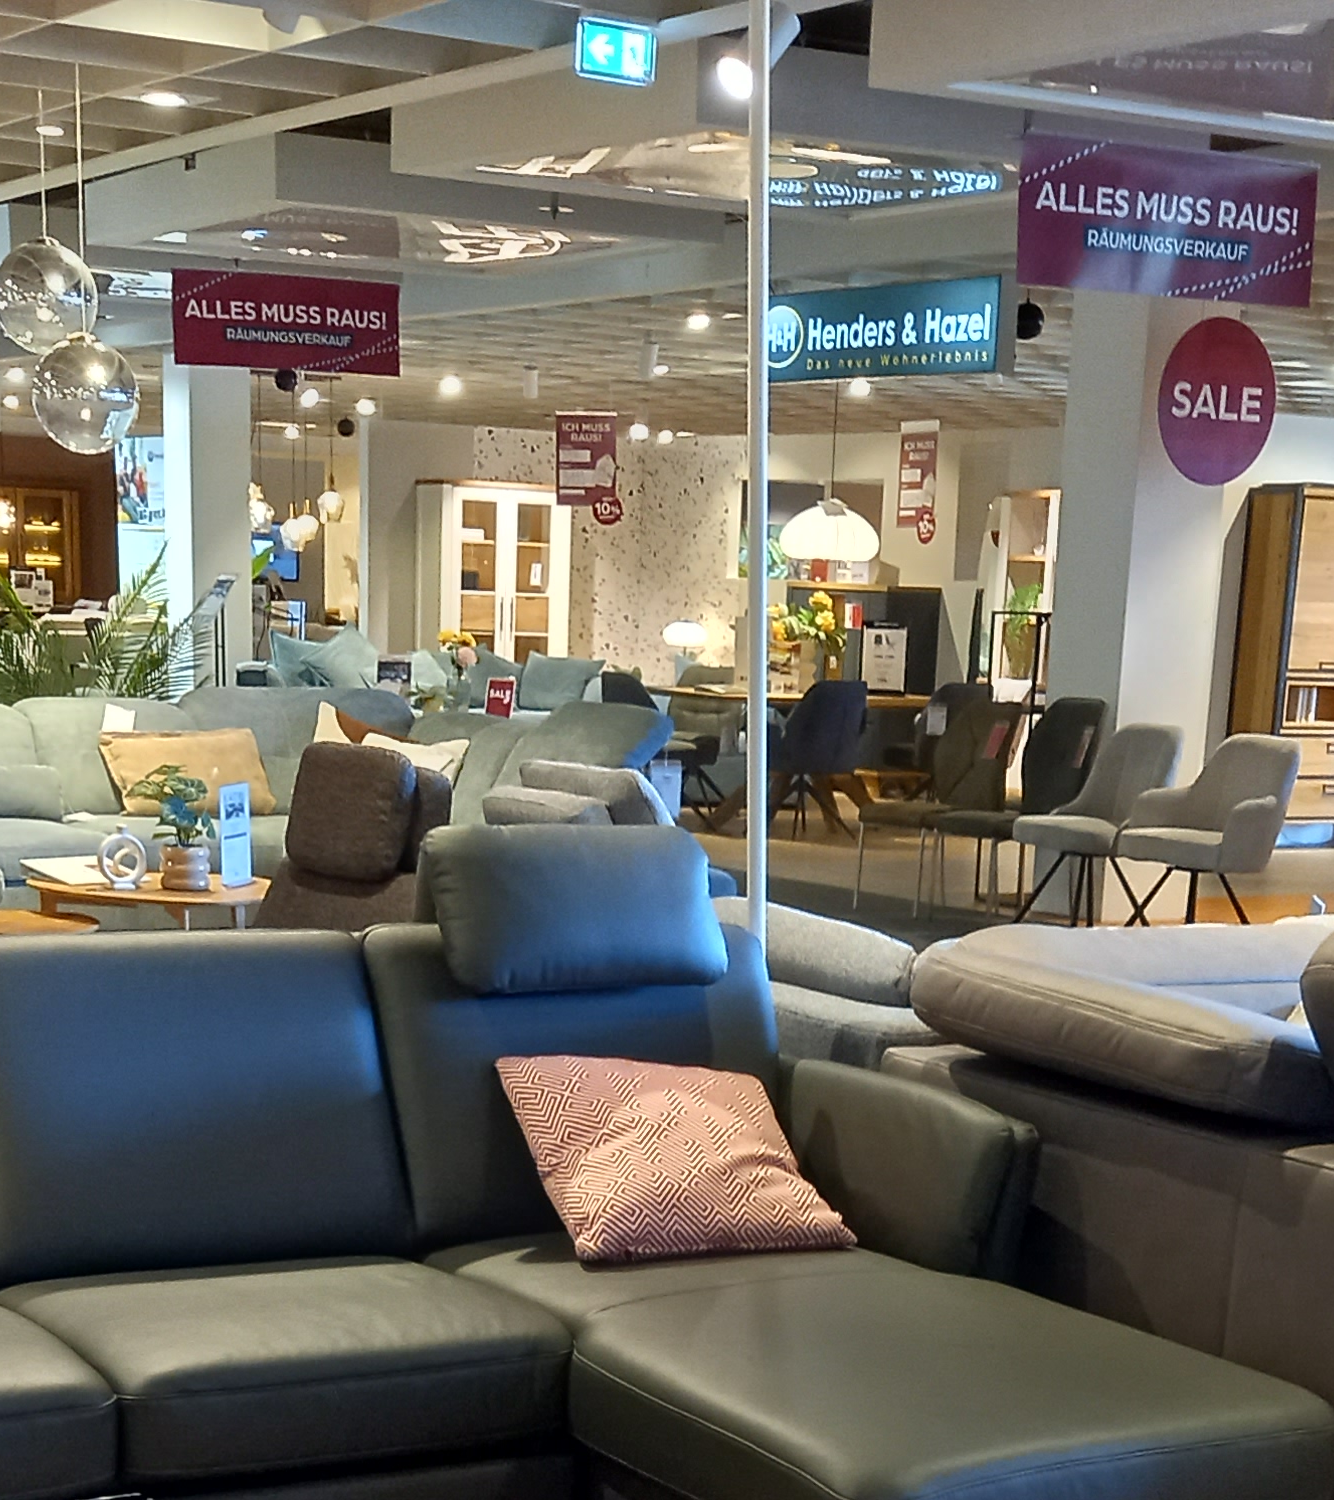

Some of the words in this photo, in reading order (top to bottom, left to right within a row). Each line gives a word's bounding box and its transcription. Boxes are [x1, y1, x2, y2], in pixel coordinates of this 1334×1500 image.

[1035, 181, 1130, 219] ALLES
[1136, 191, 1211, 227] MUSS
[1217, 200, 1299, 236] RAUS!
[1087, 227, 1249, 261] RÄUMUNGSVERKAUF
[185, 298, 257, 321] ALLES
[261, 303, 321, 325] MUSS
[326, 307, 387, 330] RAUS!
[807, 313, 895, 351] Henders
[901, 312, 917, 346] &
[924, 303, 992, 344] Hazel
[226, 327, 352, 347] RÄUMUNGSVERKAUF
[806, 358, 830, 371] Das
[838, 357, 871, 369] neue
[880, 350, 988, 367] Wohnerlebnis
[1170, 380, 1263, 425] SALE
[562, 422, 579, 431] ICH
[582, 422, 610, 432] MUSS
